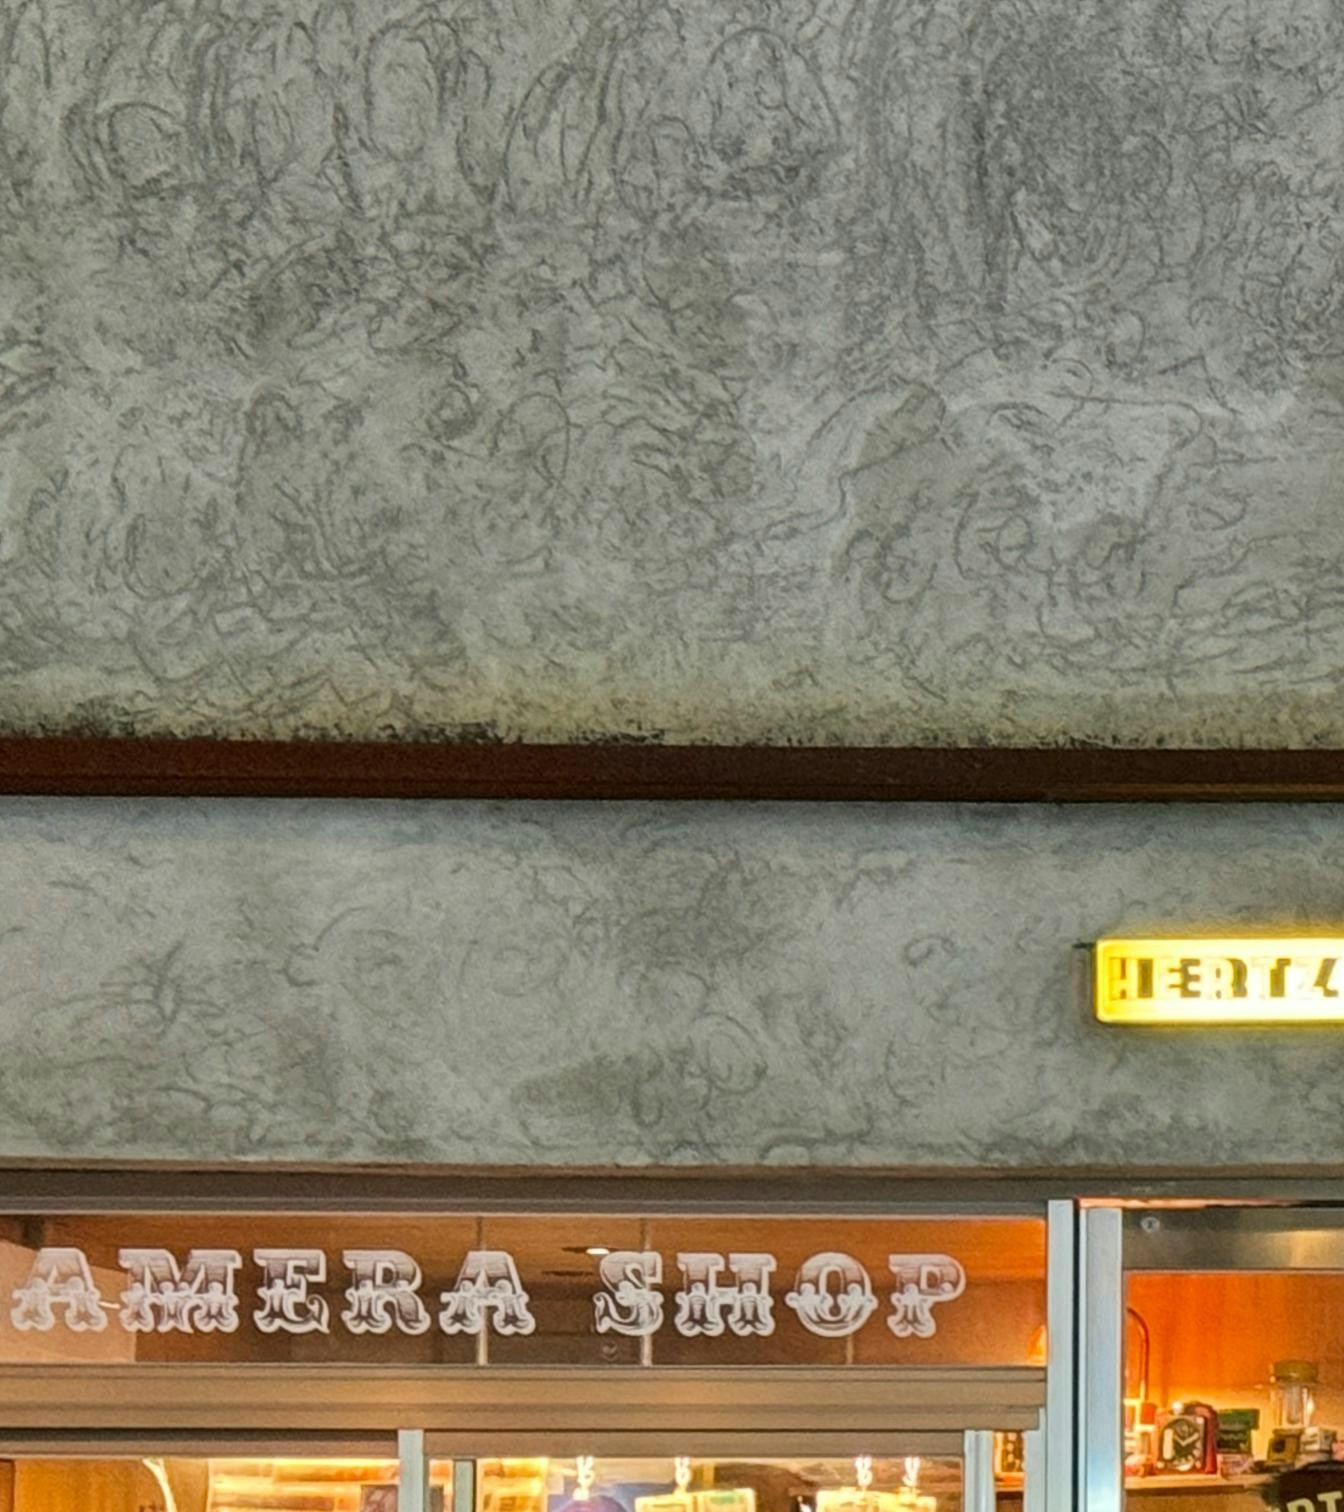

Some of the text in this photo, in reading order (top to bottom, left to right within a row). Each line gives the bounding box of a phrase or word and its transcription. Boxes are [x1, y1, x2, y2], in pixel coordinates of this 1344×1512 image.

[1110, 956, 1339, 999] HERTZ
[12, 1247, 966, 1339] AMERA SHOP
